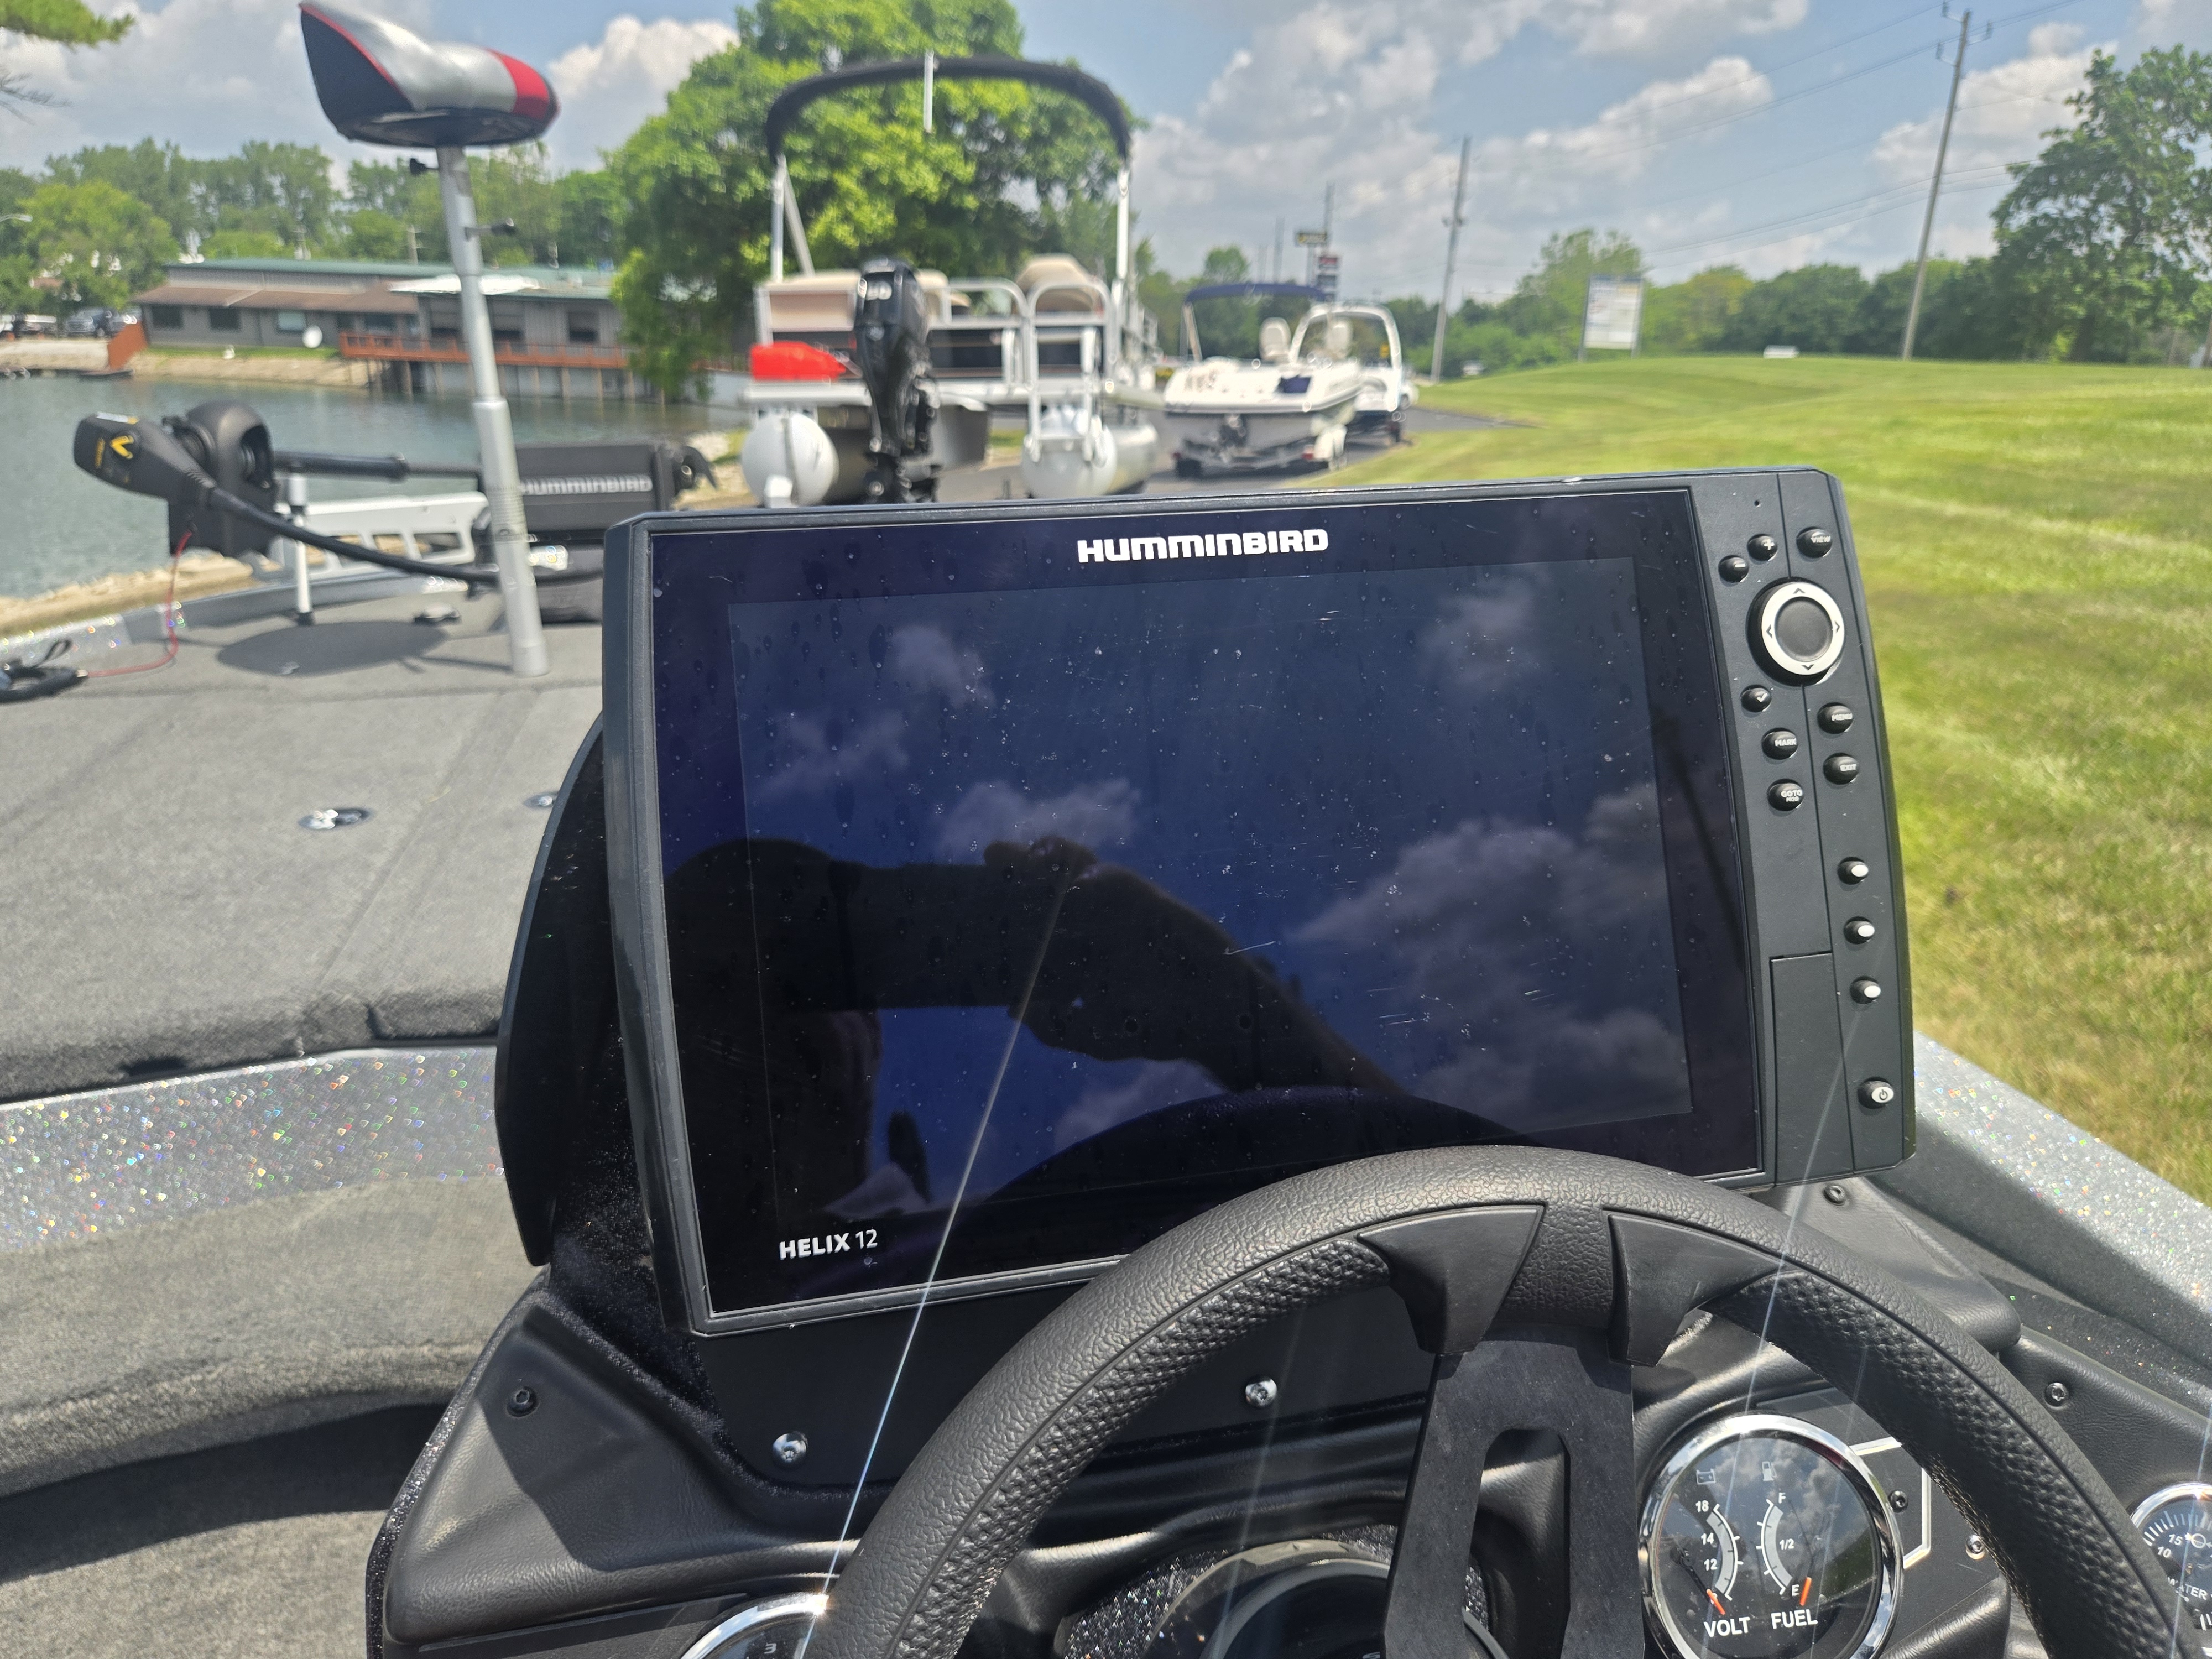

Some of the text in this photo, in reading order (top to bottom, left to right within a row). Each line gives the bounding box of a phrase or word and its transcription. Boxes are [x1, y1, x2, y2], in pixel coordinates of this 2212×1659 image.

[1077, 529, 1329, 563] HUMMINBIRD
[1831, 713, 1853, 721] MENU
[1775, 738, 1797, 747] MARK
[1839, 763, 1856, 771] EXIT
[1781, 789, 1803, 798] GOTO
[779, 1229, 878, 1260] HELIX 12
[1778, 1492, 1786, 1504] F
[1695, 1500, 1709, 1512] 18
[1700, 1532, 1714, 1545] 14
[1779, 1538, 1795, 1551] 1/2
[2169, 1533, 2183, 1546] 15
[2157, 1546, 2172, 1558] 10
[1703, 1558, 1718, 1571] 12
[1791, 1585, 1800, 1597] E
[1771, 1609, 1818, 1629] FUEL
[1703, 1616, 1751, 1638] VOLT
